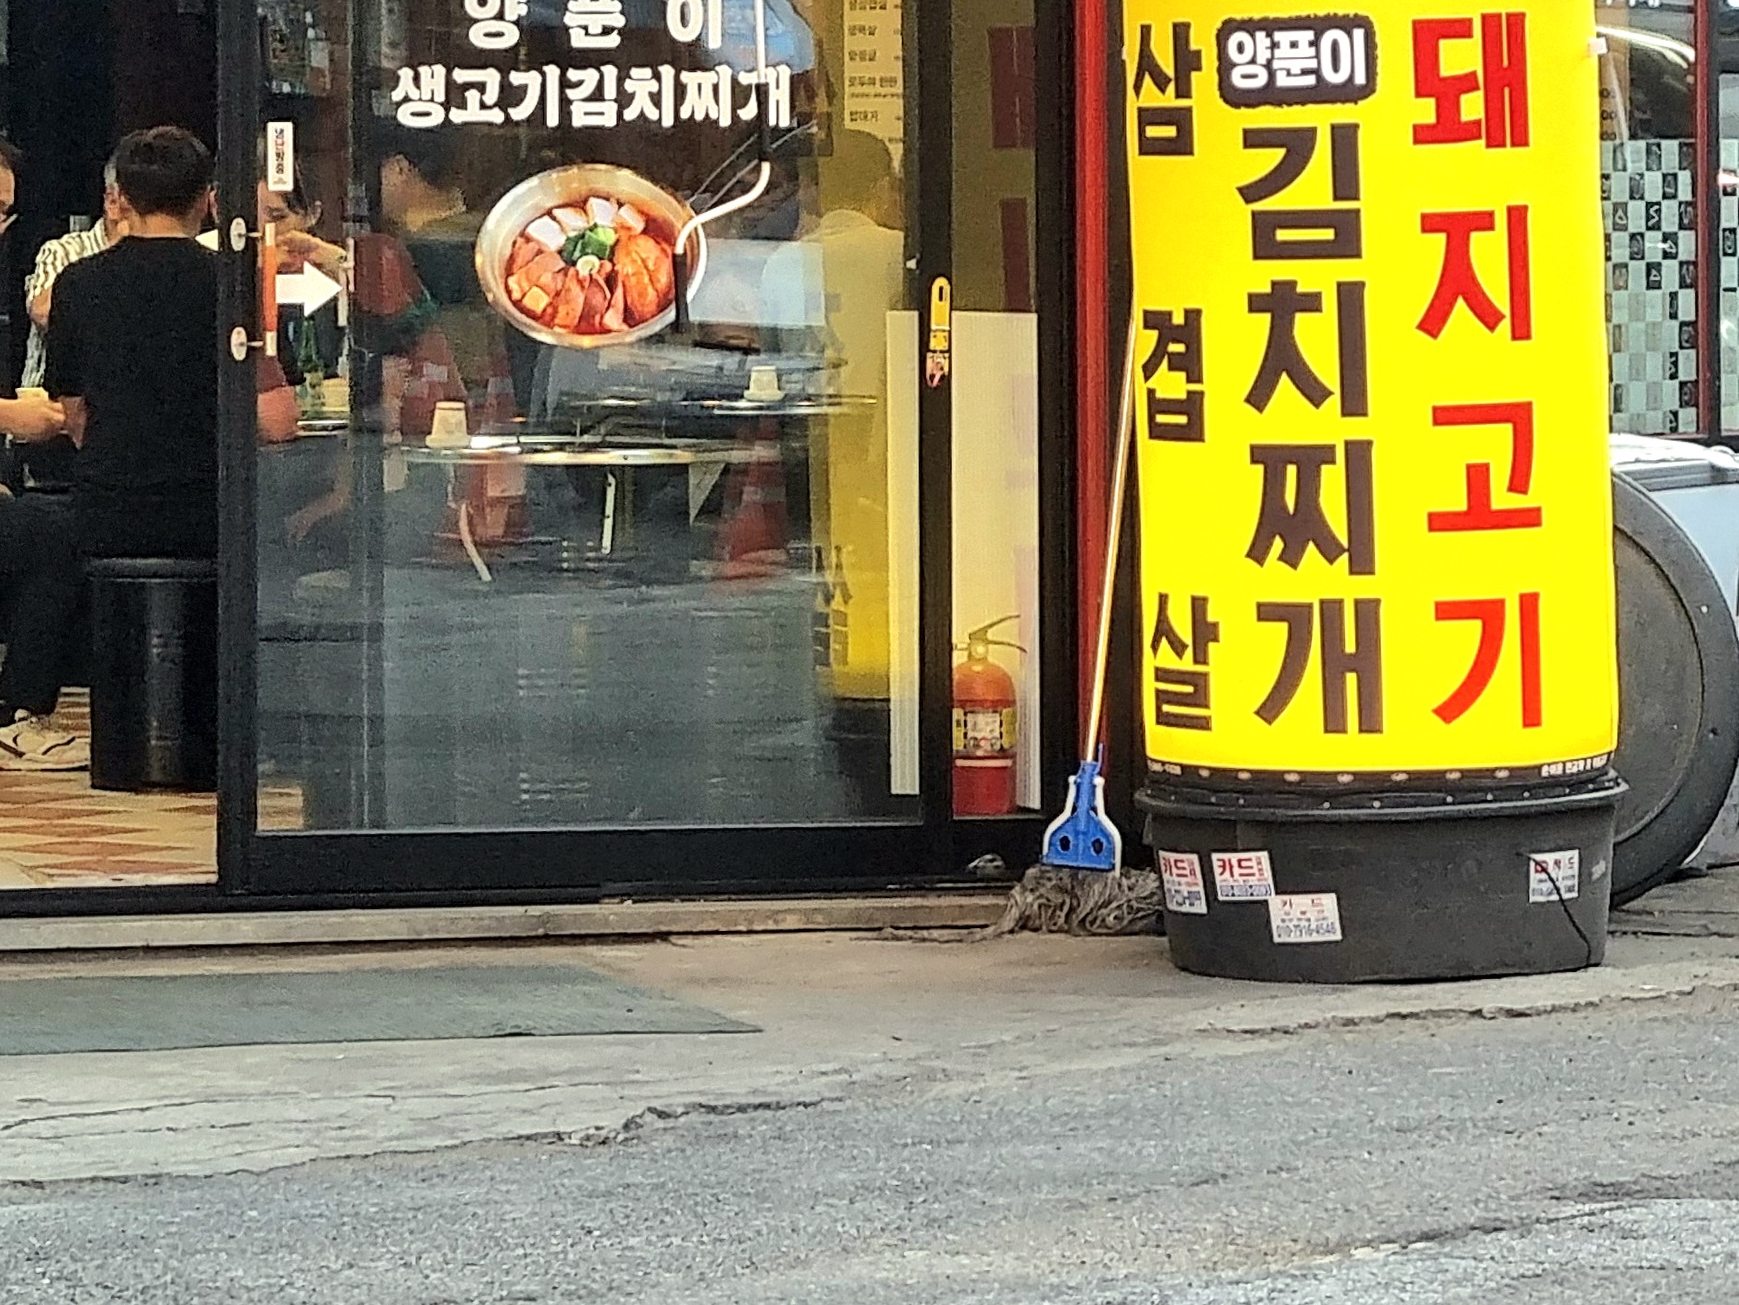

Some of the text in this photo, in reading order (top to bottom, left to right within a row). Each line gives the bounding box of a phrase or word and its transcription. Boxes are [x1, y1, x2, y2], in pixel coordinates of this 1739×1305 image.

[1226, 27, 1368, 90] 양푼이
[391, 63, 792, 129] 생고기김치찌개
[1412, 11, 1544, 730] 돼지고기
[1236, 122, 1384, 735] 김치찌개
[1217, 857, 1256, 879] 카드
